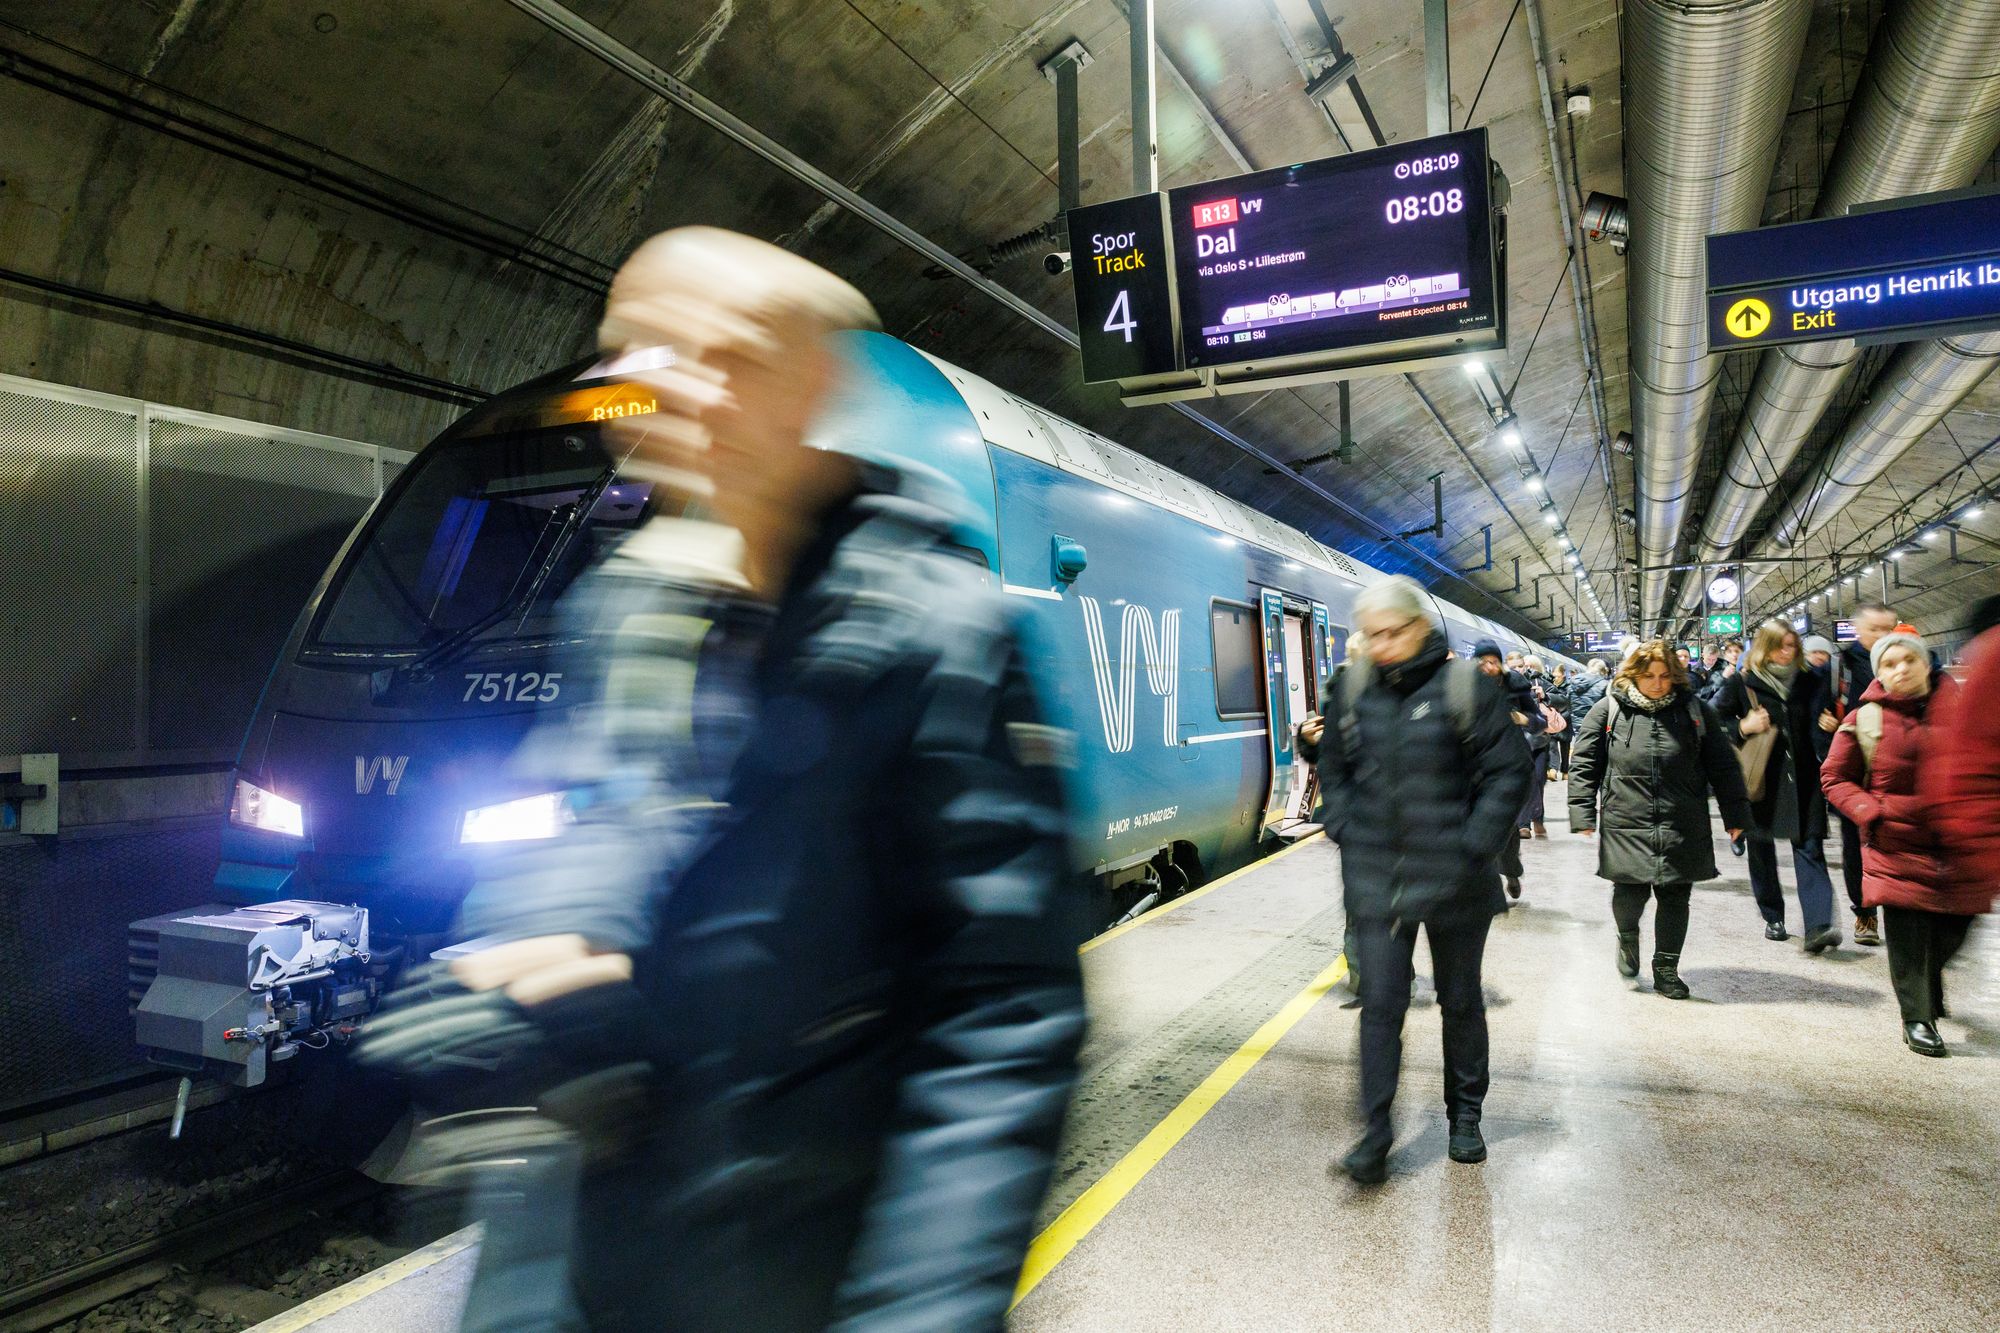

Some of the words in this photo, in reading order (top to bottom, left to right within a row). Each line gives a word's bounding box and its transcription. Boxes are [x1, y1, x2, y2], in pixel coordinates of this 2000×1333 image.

[1412, 153, 1459, 176] 08:09
[1386, 188, 1463, 224] 08:08
[1092, 231, 1136, 256] Spor
[1197, 228, 1236, 257] Dal
[1093, 248, 1146, 275] Track
[1198, 265, 1213, 277] via
[1215, 262, 1237, 275] Oslo
[1239, 260, 1247, 270] S
[1256, 250, 1305, 267] Lillestrøm
[1433, 283, 1442, 291] 10
[1792, 283, 1881, 309] Utgang
[1888, 268, 1973, 295] Henrik
[1103, 290, 1137, 343] 4
[1379, 309, 1412, 321] Forventet
[1413, 304, 1445, 316] Expected
[1446, 301, 1468, 311] 08:14
[1793, 310, 1836, 331] Exit
[1207, 335, 1229, 346] 08:10
[627, 399, 656, 416] Dal
[462, 672, 563, 702] 75125
[1106, 817, 1130, 840] N-NOR
